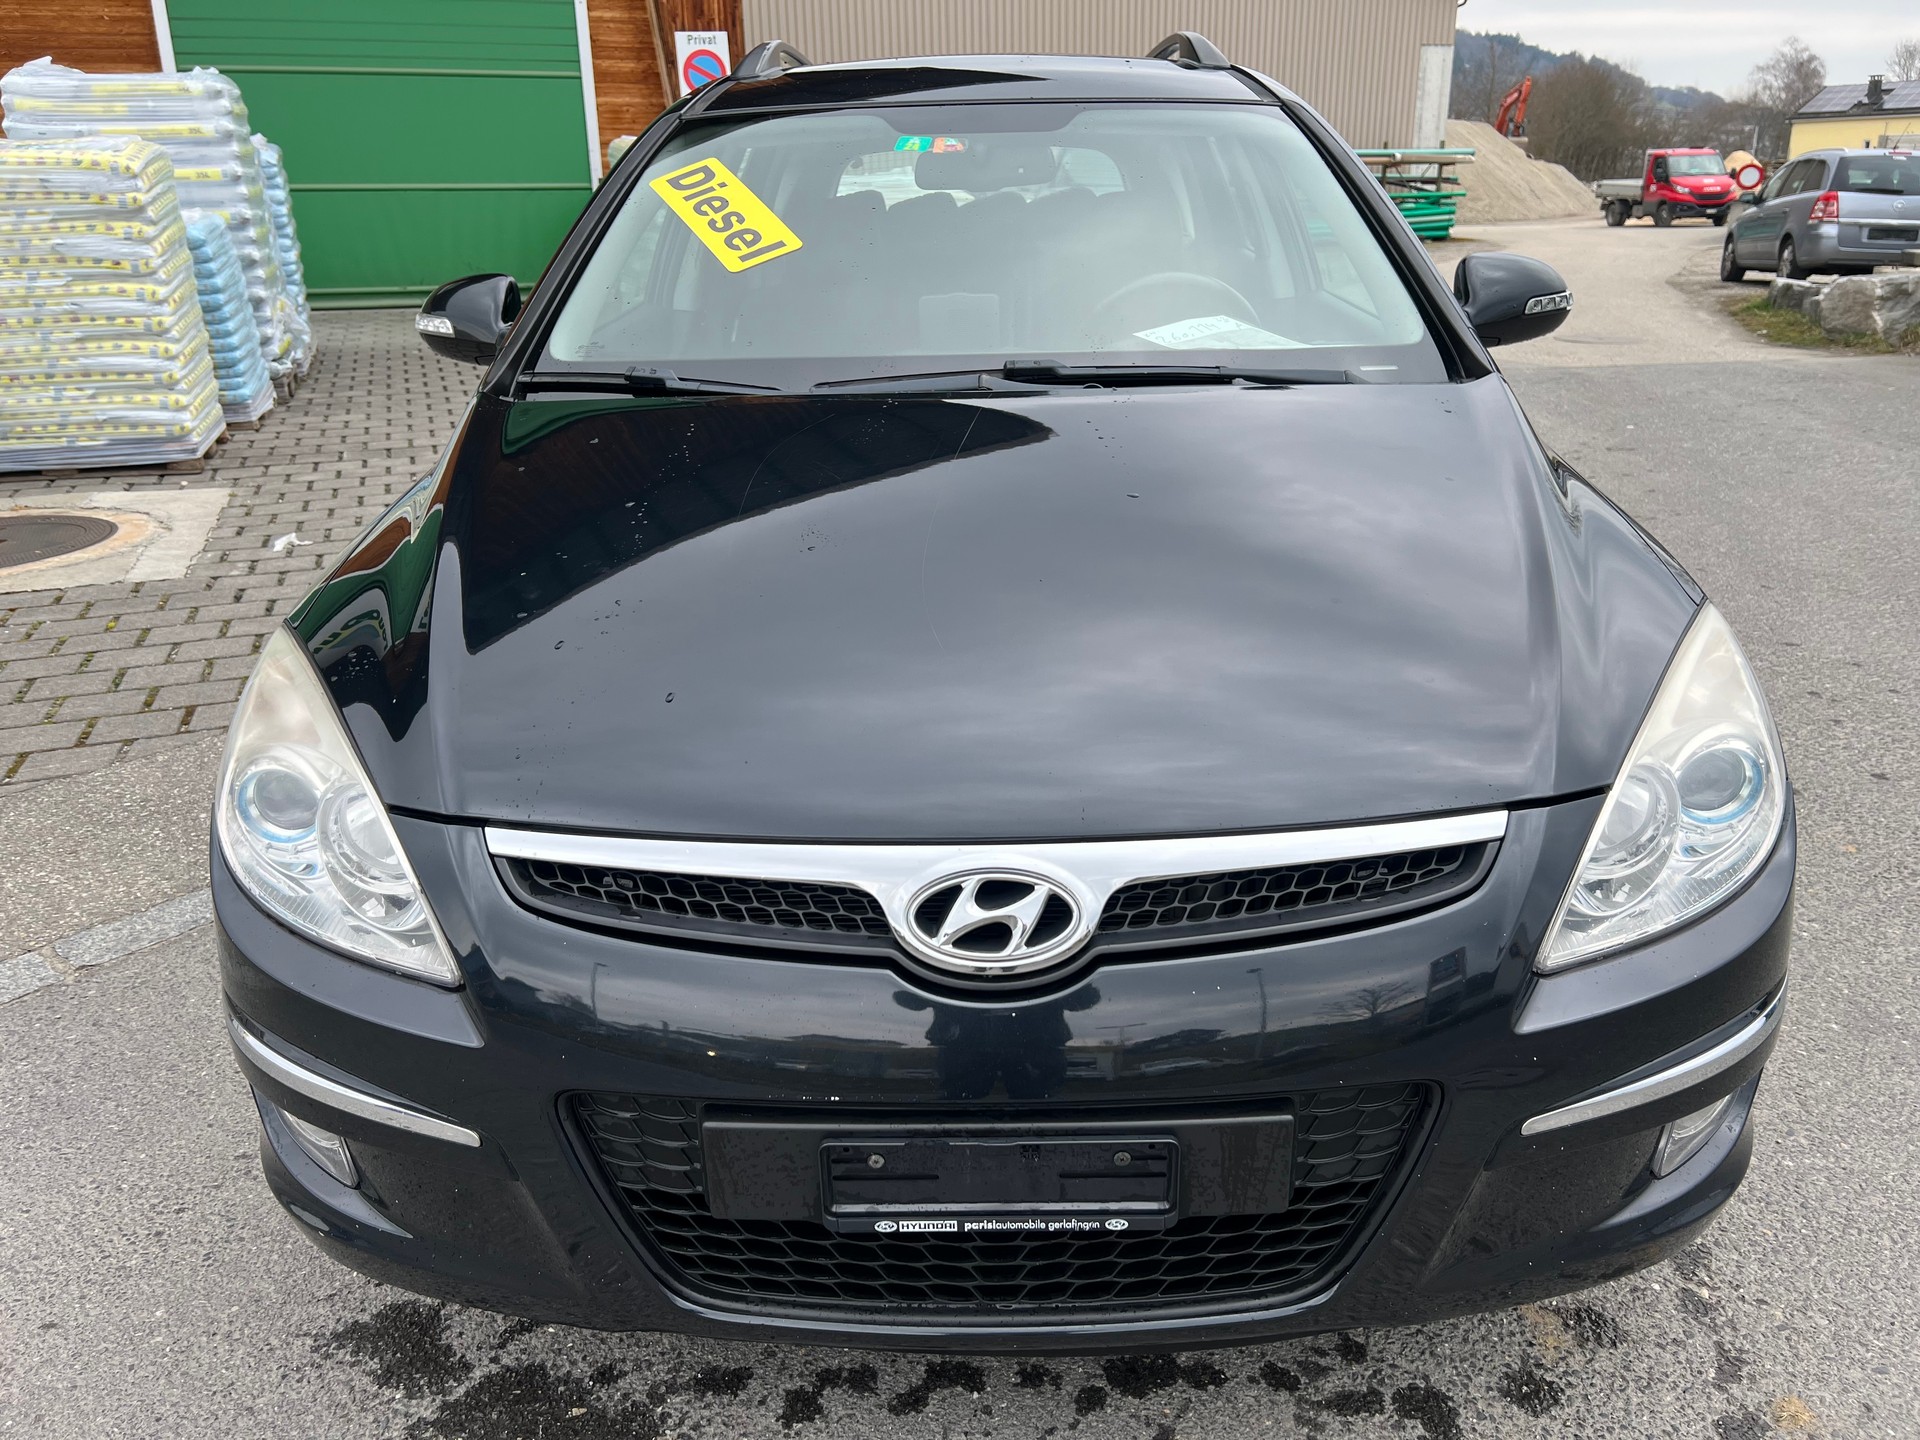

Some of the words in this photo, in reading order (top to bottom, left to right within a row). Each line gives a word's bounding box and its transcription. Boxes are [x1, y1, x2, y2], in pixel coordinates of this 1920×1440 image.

[687, 34, 717, 45] Privat
[665, 164, 788, 263] Diesel
[900, 1221, 957, 1232] HYUNDAI
